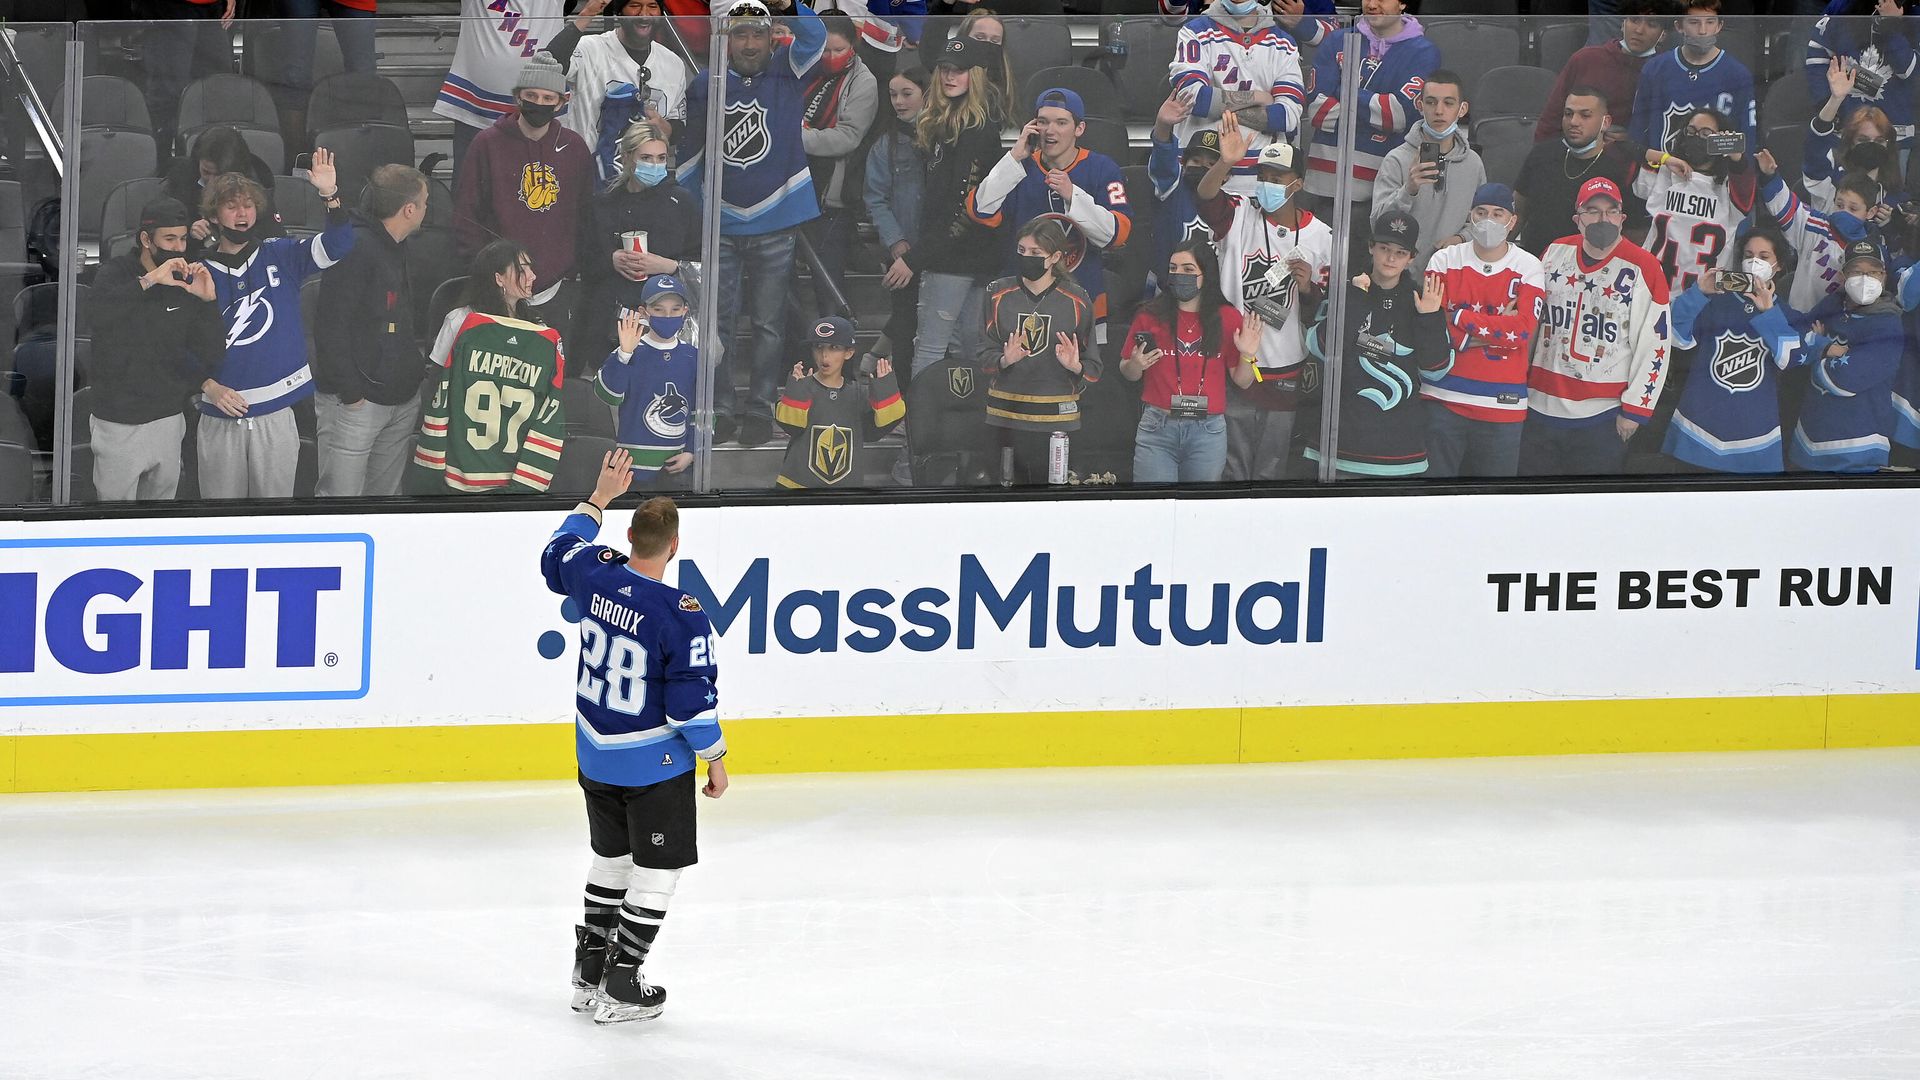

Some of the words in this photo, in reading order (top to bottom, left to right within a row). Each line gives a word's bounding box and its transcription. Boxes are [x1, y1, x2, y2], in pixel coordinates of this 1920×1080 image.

[1178, 39, 1201, 63] 10
[1717, 92, 1734, 116] C
[726, 116, 759, 154] NHL
[1106, 181, 1128, 206] 2
[1664, 190, 1717, 219] WILSON
[1650, 212, 1727, 292] 43
[266, 264, 281, 288] C
[1507, 277, 1521, 299] C
[1613, 267, 1636, 294] C
[1533, 296, 1543, 321] 8
[1653, 310, 1668, 341] 4
[468, 349, 543, 388] KAPRIZOV
[1721, 352, 1757, 376] NHL
[464, 380, 536, 454] 97
[678, 547, 1328, 655] MassMutual
[1487, 572, 1597, 612] THE
[1617, 568, 1761, 610] BEST
[1779, 566, 1893, 607] RUN
[590, 593, 645, 636] GIROUX
[577, 616, 649, 717] 28
